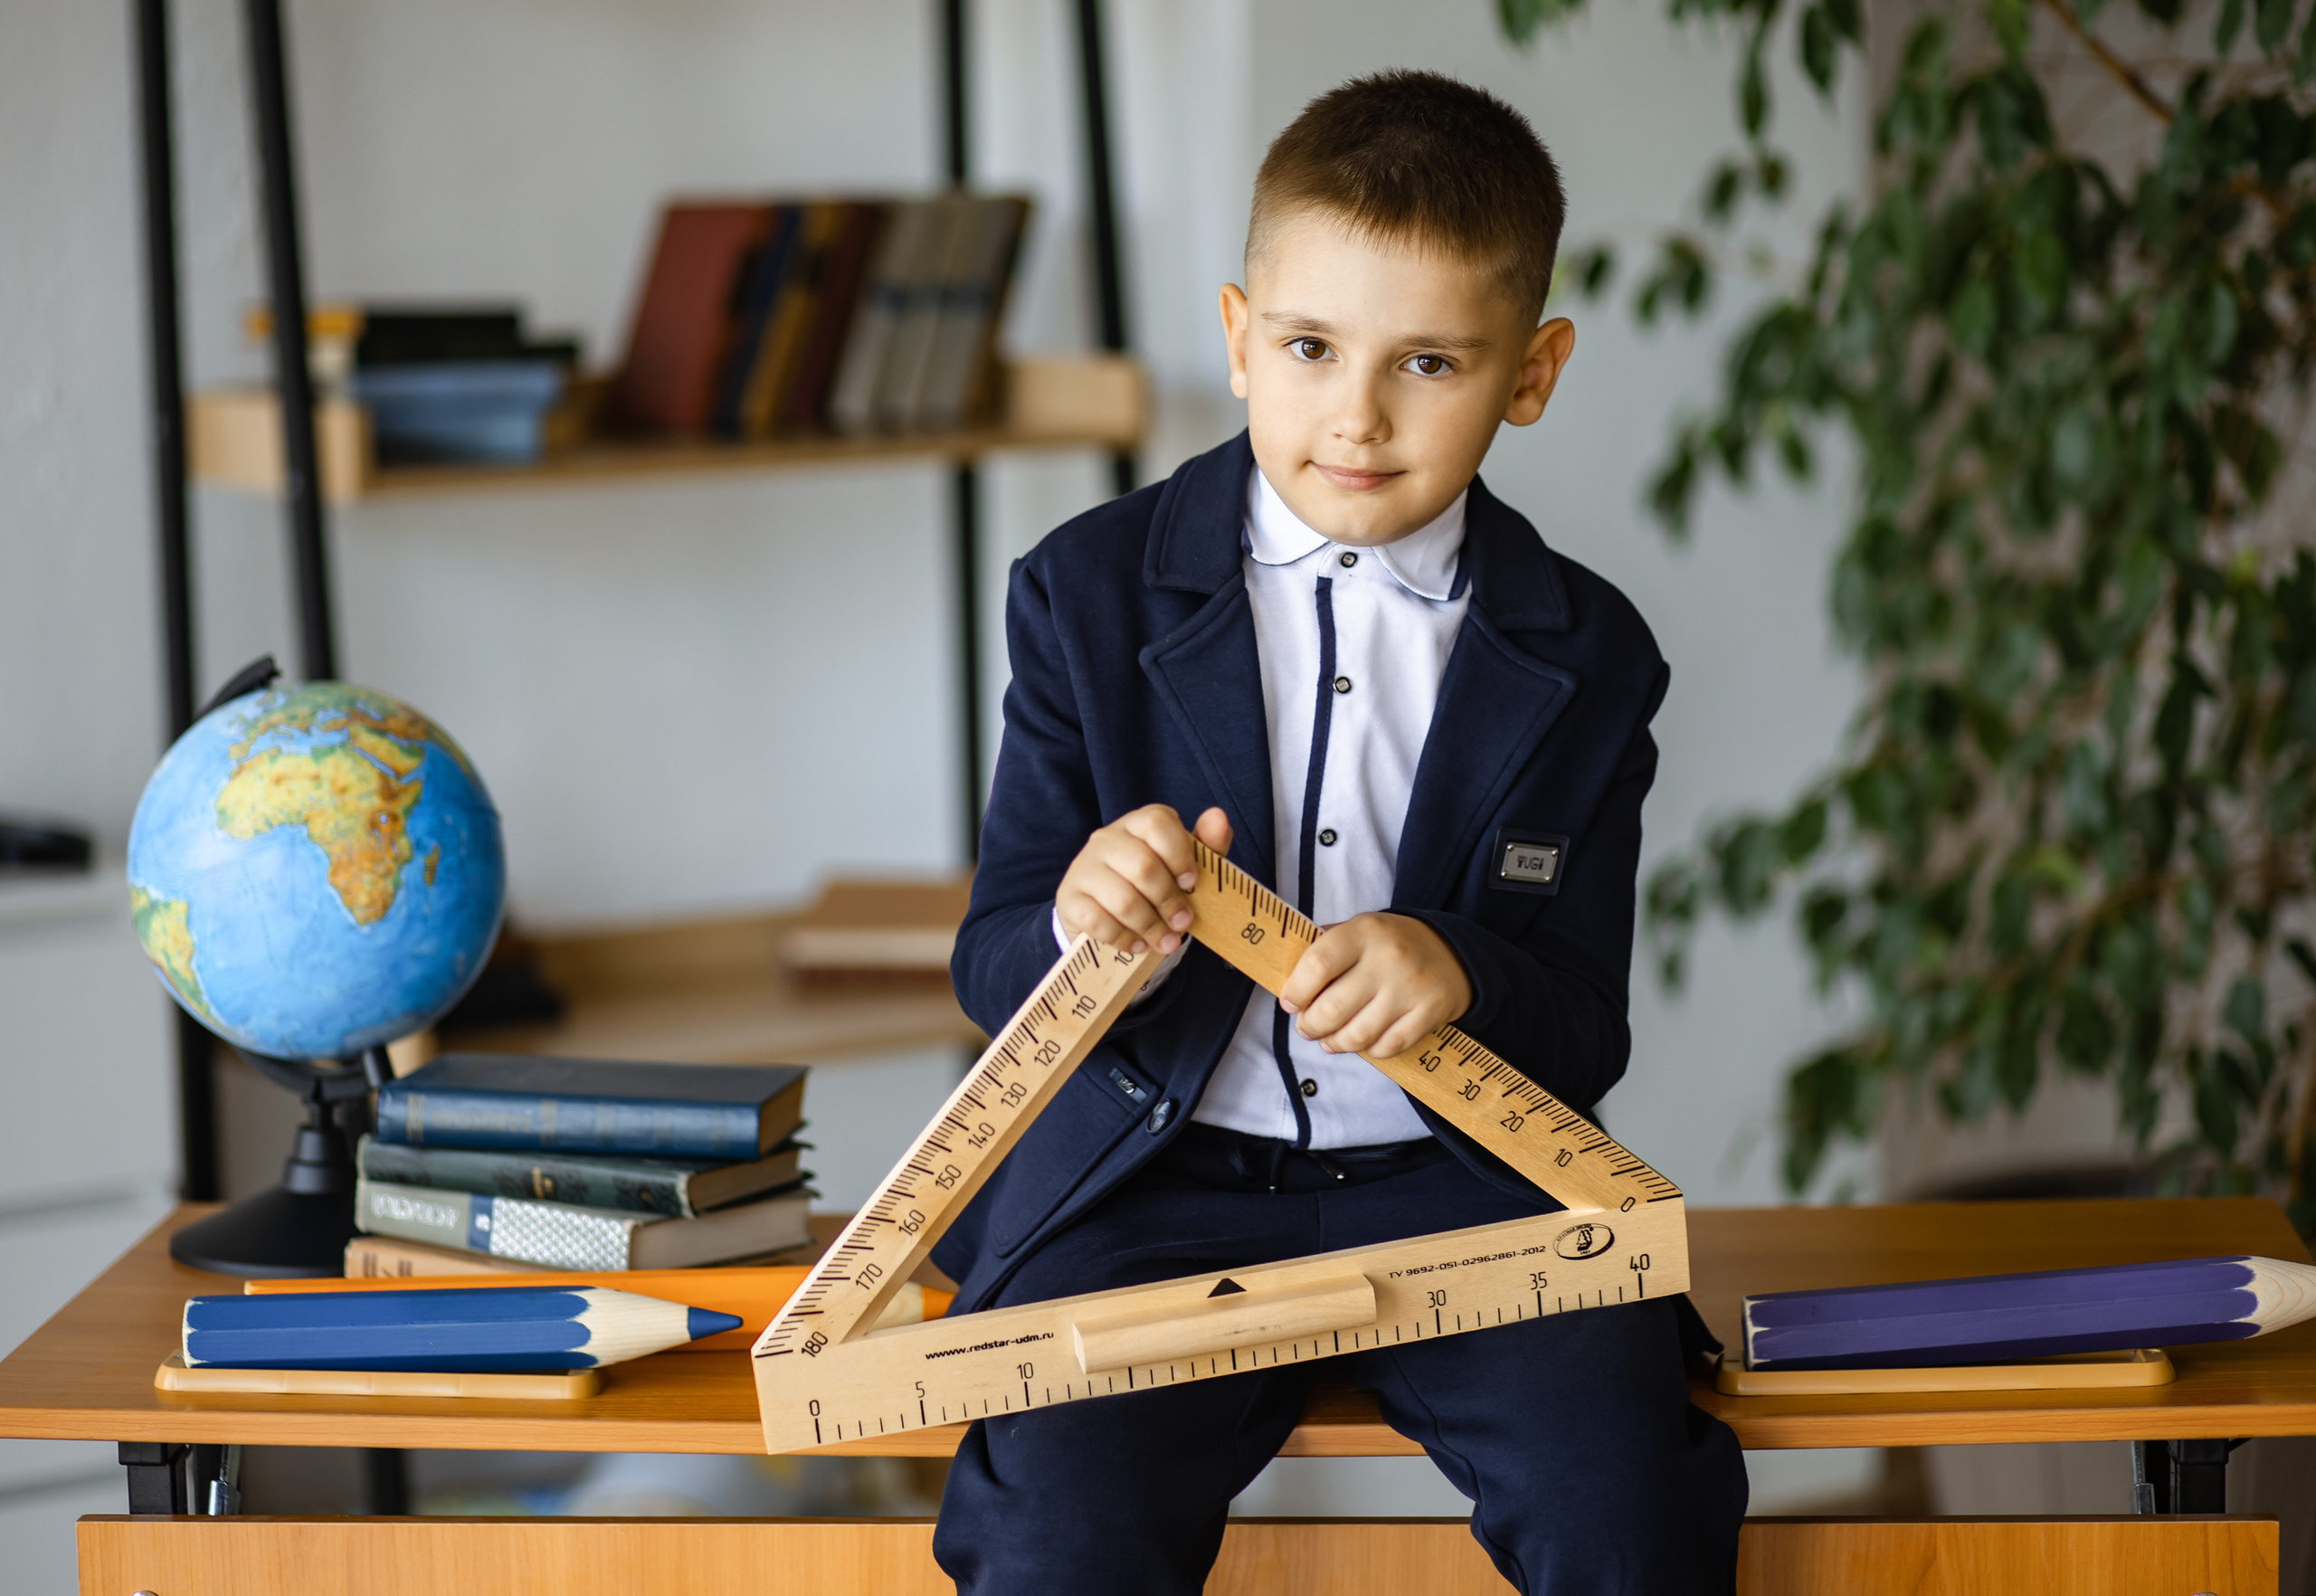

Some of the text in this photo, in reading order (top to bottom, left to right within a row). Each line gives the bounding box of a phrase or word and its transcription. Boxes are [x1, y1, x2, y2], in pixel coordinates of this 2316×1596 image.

[1516, 855, 1544, 871] TUGI
[1240, 922, 1266, 945] 80
[1114, 949, 1134, 967] 10
[1071, 994, 1097, 1021] 110
[1033, 1039, 1062, 1068] 120
[1418, 1054, 1442, 1074] 40
[1000, 1081, 1029, 1109] 130
[1457, 1078, 1482, 1102] 30
[1499, 1110, 1525, 1133] 20
[967, 1121, 996, 1150] 140
[1553, 1147, 1574, 1169] 10
[934, 1163, 963, 1191] 150
[1619, 1196, 1637, 1213] 0
[897, 1208, 926, 1237] 160
[1405, 1245, 1546, 1277] 9692-051-02962861-2012
[1628, 1252, 1651, 1272] 40
[855, 1262, 884, 1291] 170
[1528, 1270, 1549, 1290] 35
[1427, 1288, 1448, 1308] 30
[800, 1330, 830, 1358] 180
[1015, 1362, 1035, 1380] 10
[915, 1381, 926, 1399] 5
[808, 1399, 821, 1418] 0
